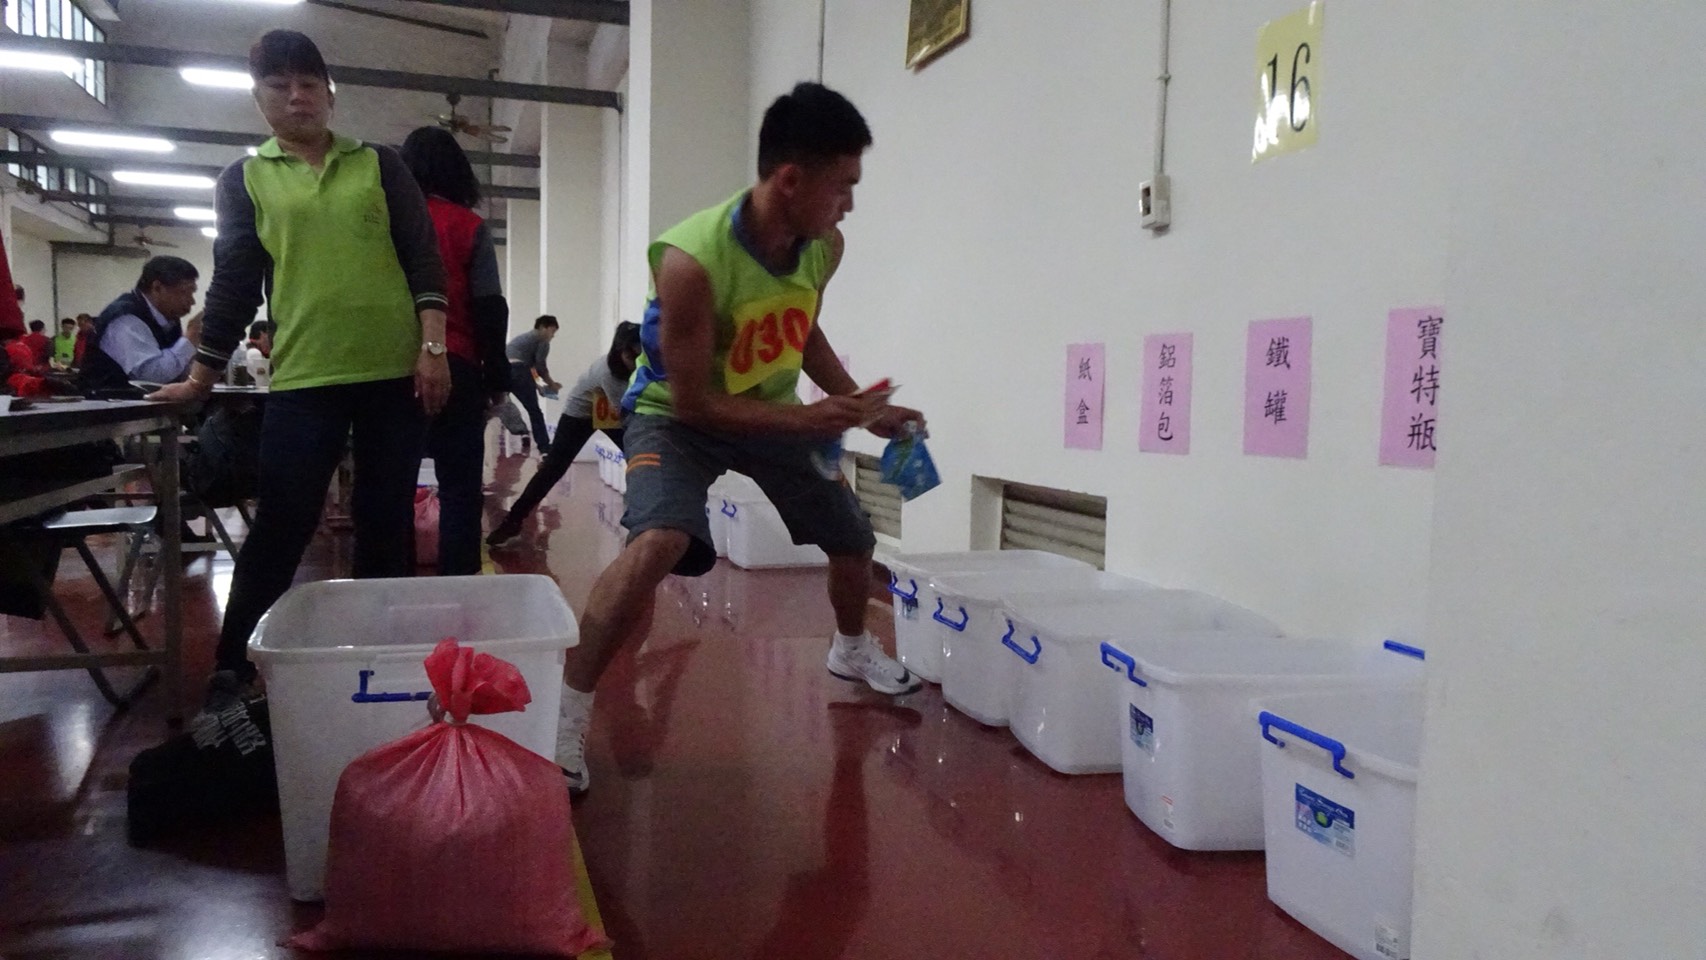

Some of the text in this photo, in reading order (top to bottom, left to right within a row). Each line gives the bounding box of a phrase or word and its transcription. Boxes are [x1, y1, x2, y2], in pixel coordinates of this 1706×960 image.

[1267, 41, 1311, 133] 16
[1076, 357, 1092, 425] 紙盒
[1157, 343, 1176, 441] 鋁箔包
[1264, 336, 1291, 425] 鐵罐
[1407, 315, 1444, 451] 寶特瓶
